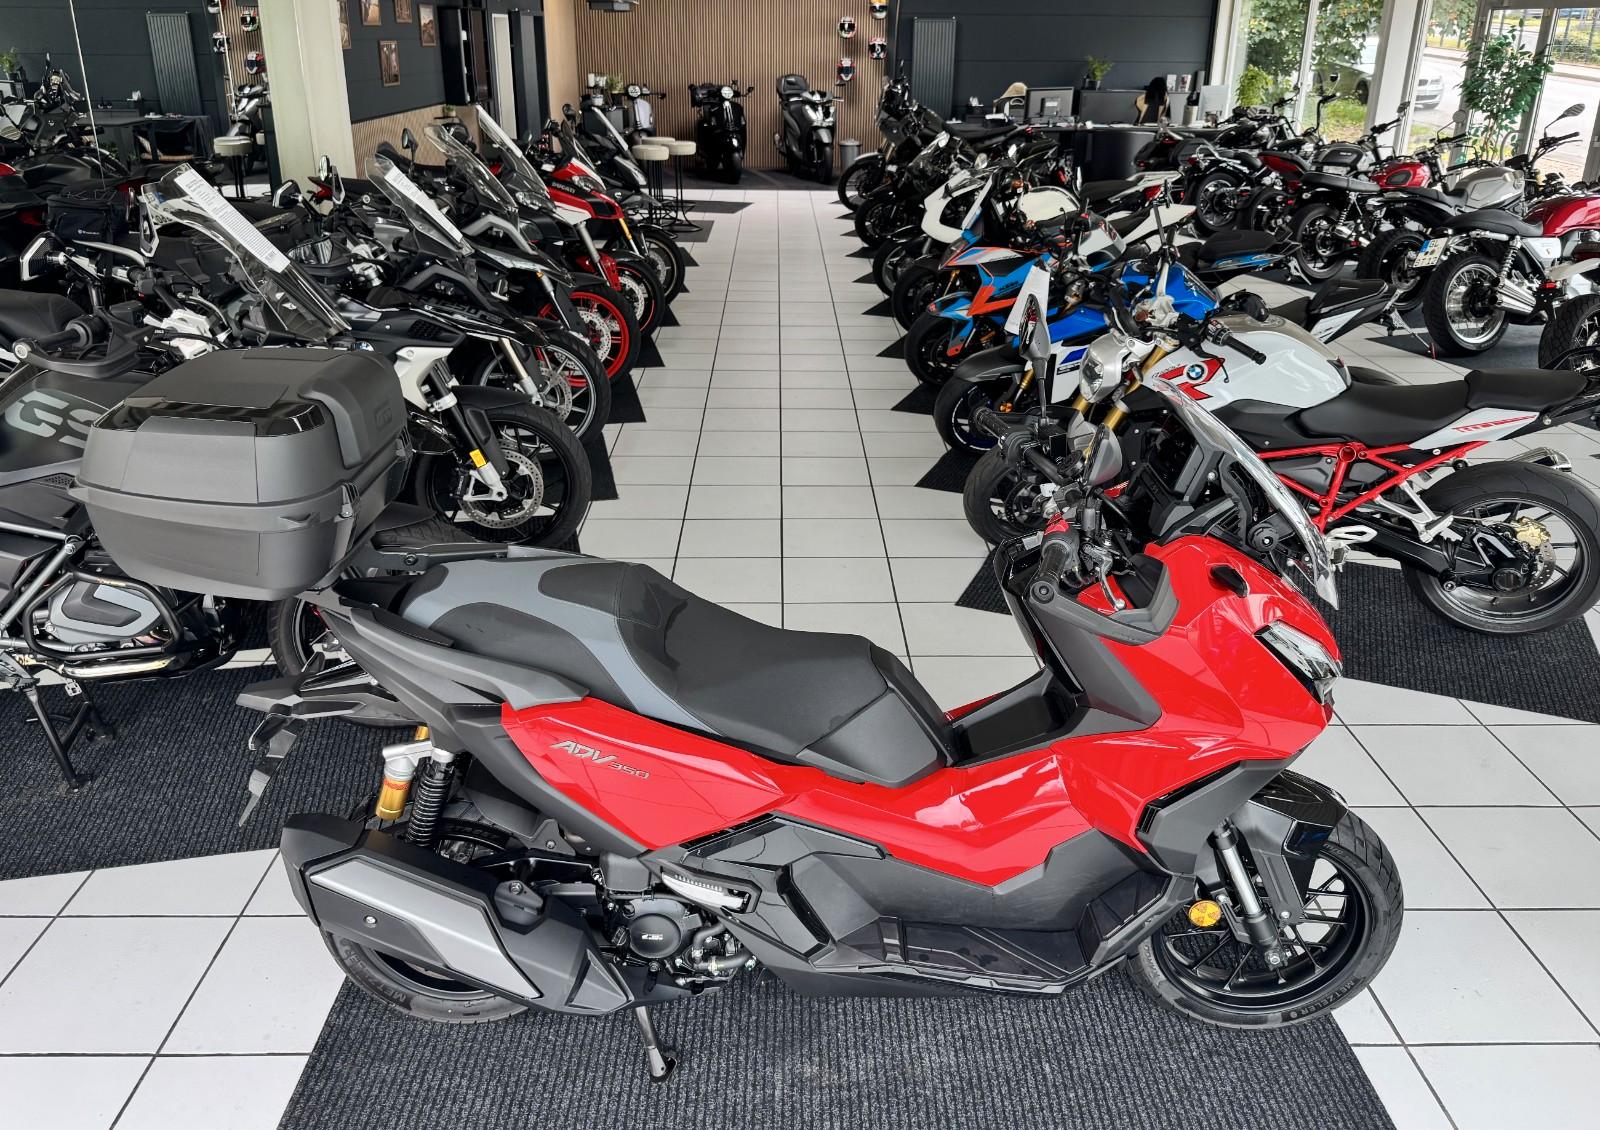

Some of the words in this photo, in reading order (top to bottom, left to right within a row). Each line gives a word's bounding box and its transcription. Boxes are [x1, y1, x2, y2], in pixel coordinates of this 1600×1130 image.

[551, 181, 576, 195] DUCATI
[4, 390, 104, 449] GS
[549, 740, 618, 764] ADV
[607, 761, 651, 780] 350
[1301, 980, 1355, 1015] METZELER
